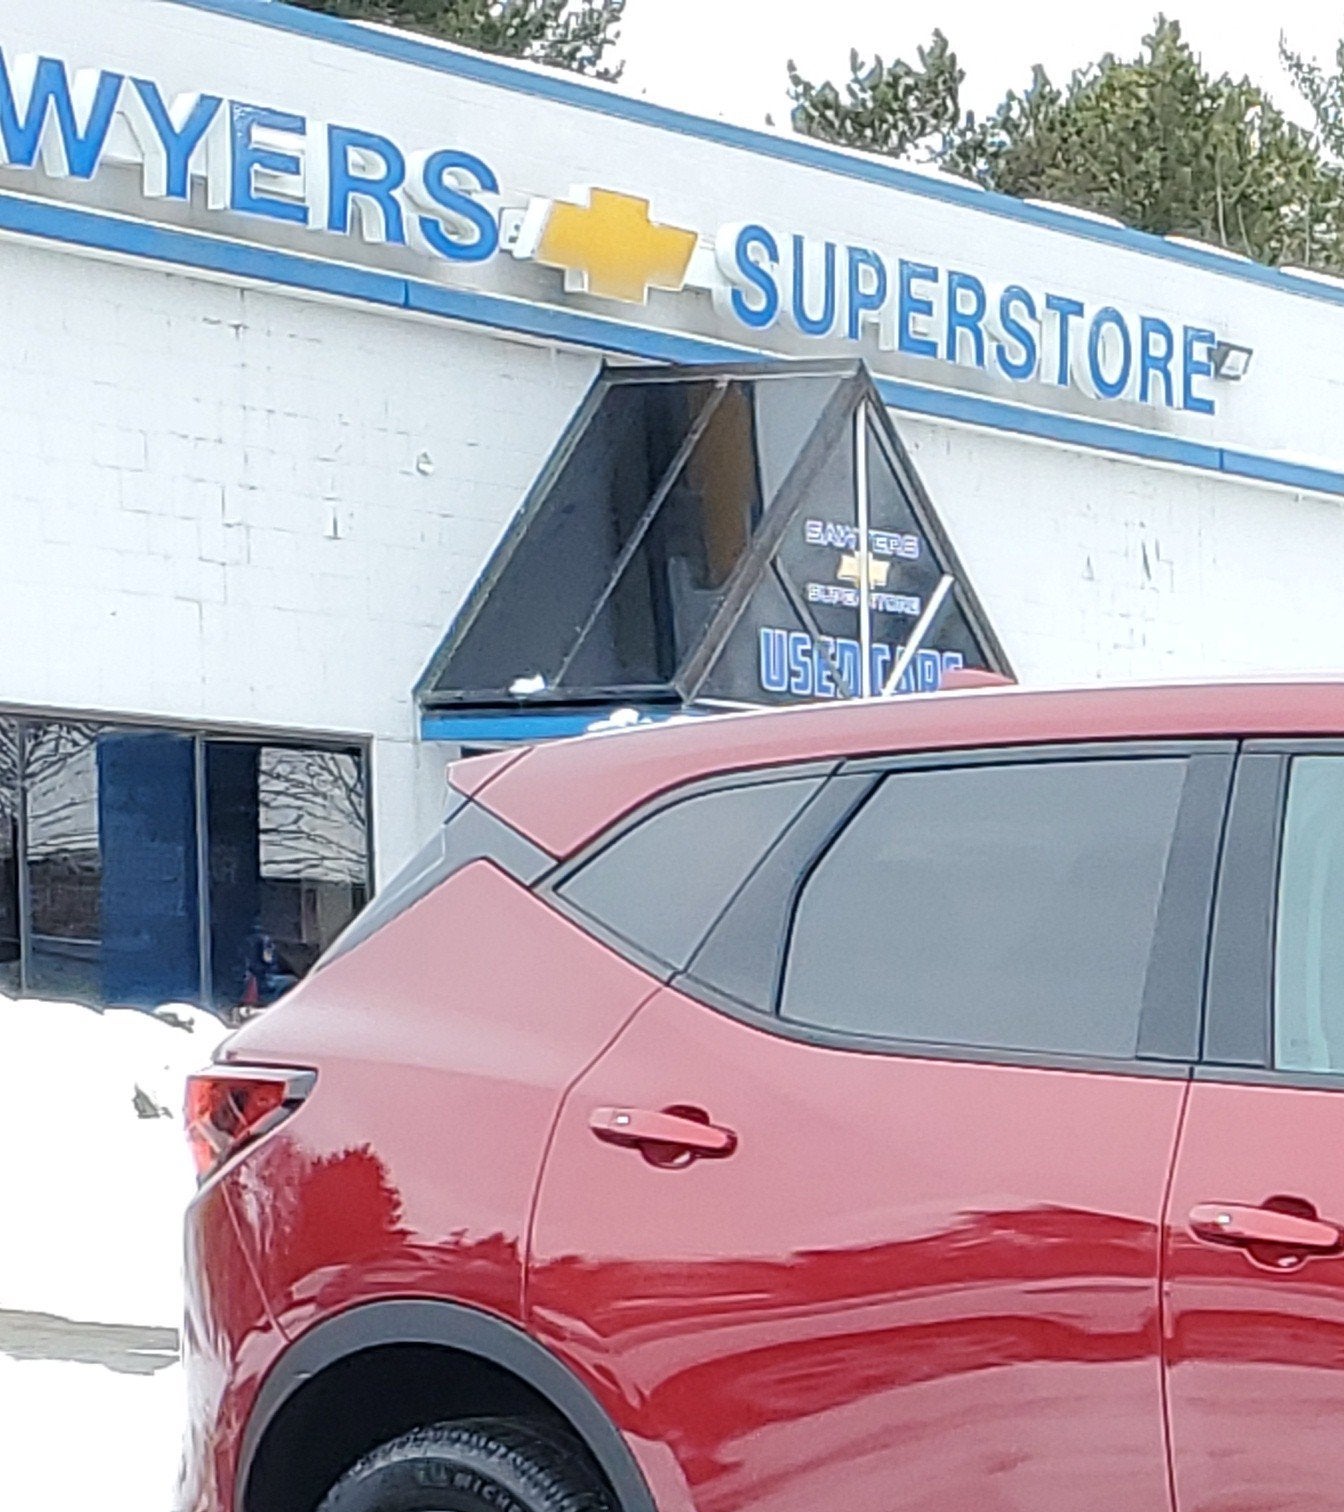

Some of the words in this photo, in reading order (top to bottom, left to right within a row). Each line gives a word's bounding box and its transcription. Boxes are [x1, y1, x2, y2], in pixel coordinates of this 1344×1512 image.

[0, 46, 500, 264] WYERS
[731, 223, 1216, 415] SUPERSTORE
[807, 583, 921, 615] SUPETORE
[759, 627, 862, 698] USED
